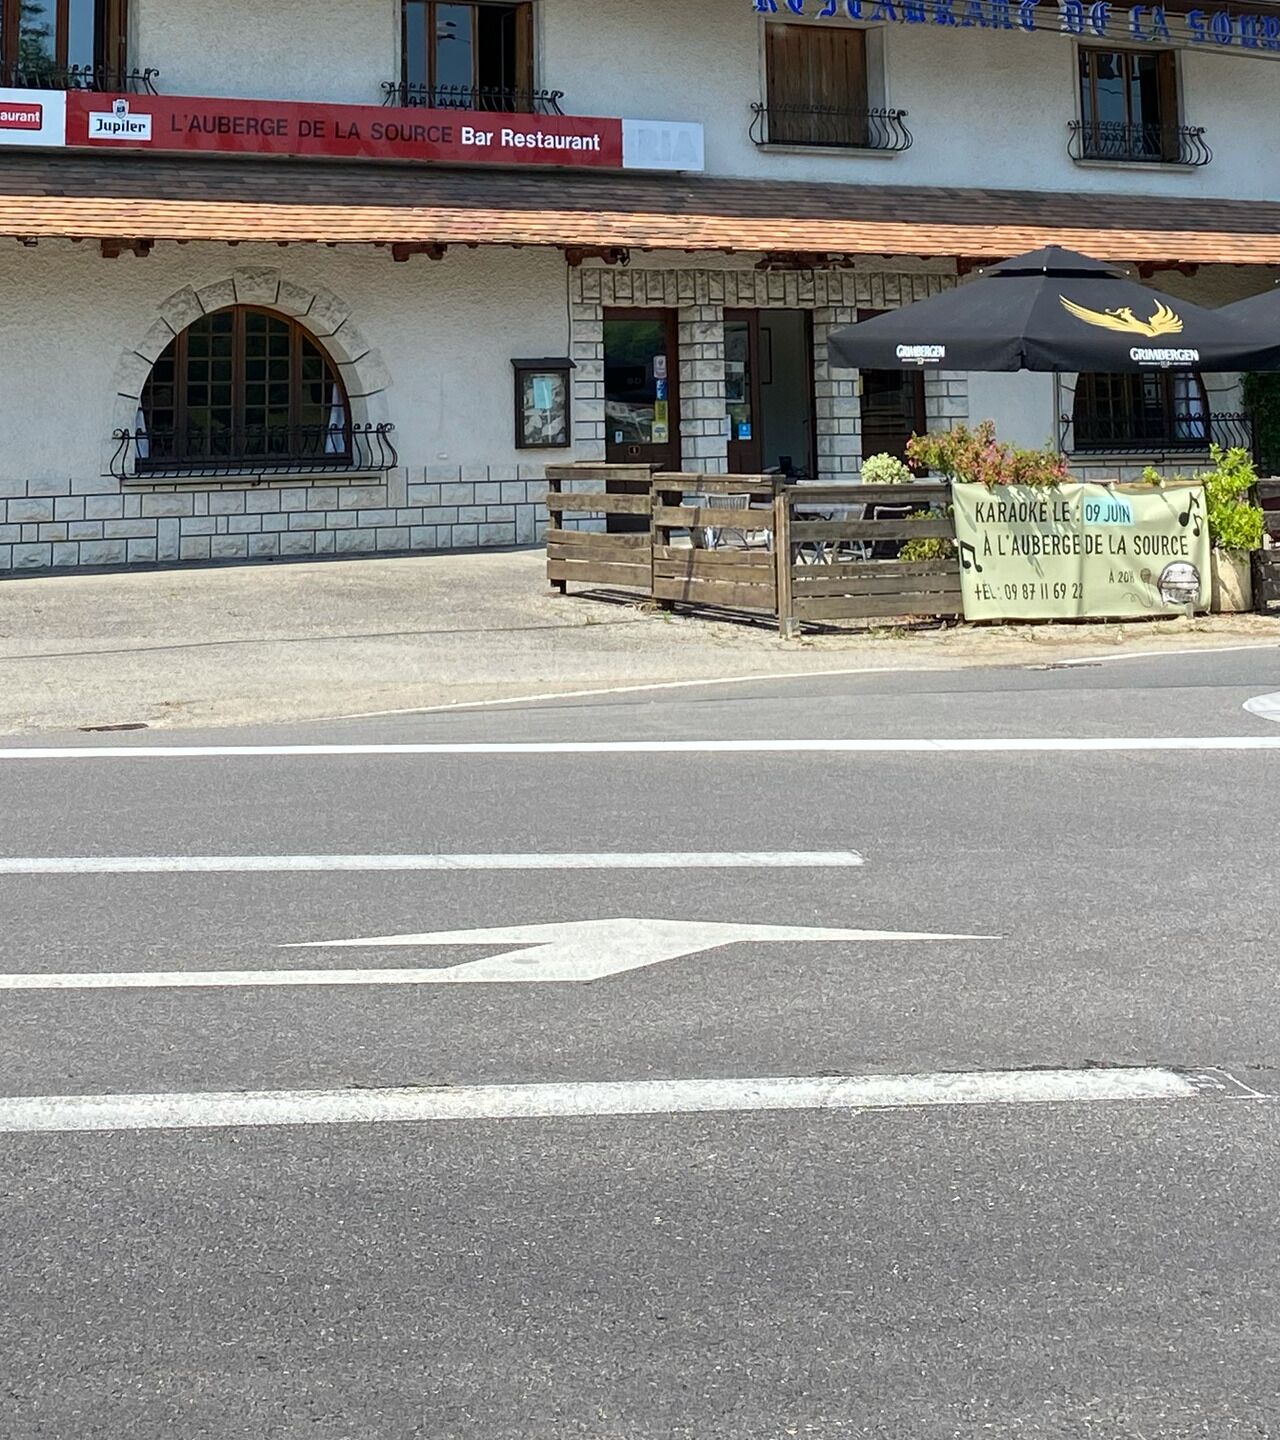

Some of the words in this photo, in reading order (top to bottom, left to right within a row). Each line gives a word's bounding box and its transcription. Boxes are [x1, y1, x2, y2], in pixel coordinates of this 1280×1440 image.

[95, 118, 146, 134] Jupiler
[171, 113, 289, 137] L'AUBERGE
[298, 119, 326, 139] DE
[334, 121, 361, 141] LA
[370, 123, 453, 144] SOURCE
[461, 127, 494, 146] Bar
[501, 128, 600, 151] Restaurant
[1129, 347, 1200, 361] GRIMBERGEN
[1053, 501, 1070, 523] LE
[1085, 503, 1101, 522] 09
[1103, 504, 1132, 524] JUIN
[998, 533, 1080, 556] L'AUBERGE
[1085, 536, 1104, 554] DE
[1108, 534, 1127, 556] LA
[1133, 535, 1189, 556] SOURCE
[1004, 582, 1018, 601] 09
[1021, 582, 1036, 601] 87
[1053, 582, 1067, 600] 69
[1071, 582, 1083, 600] 22
